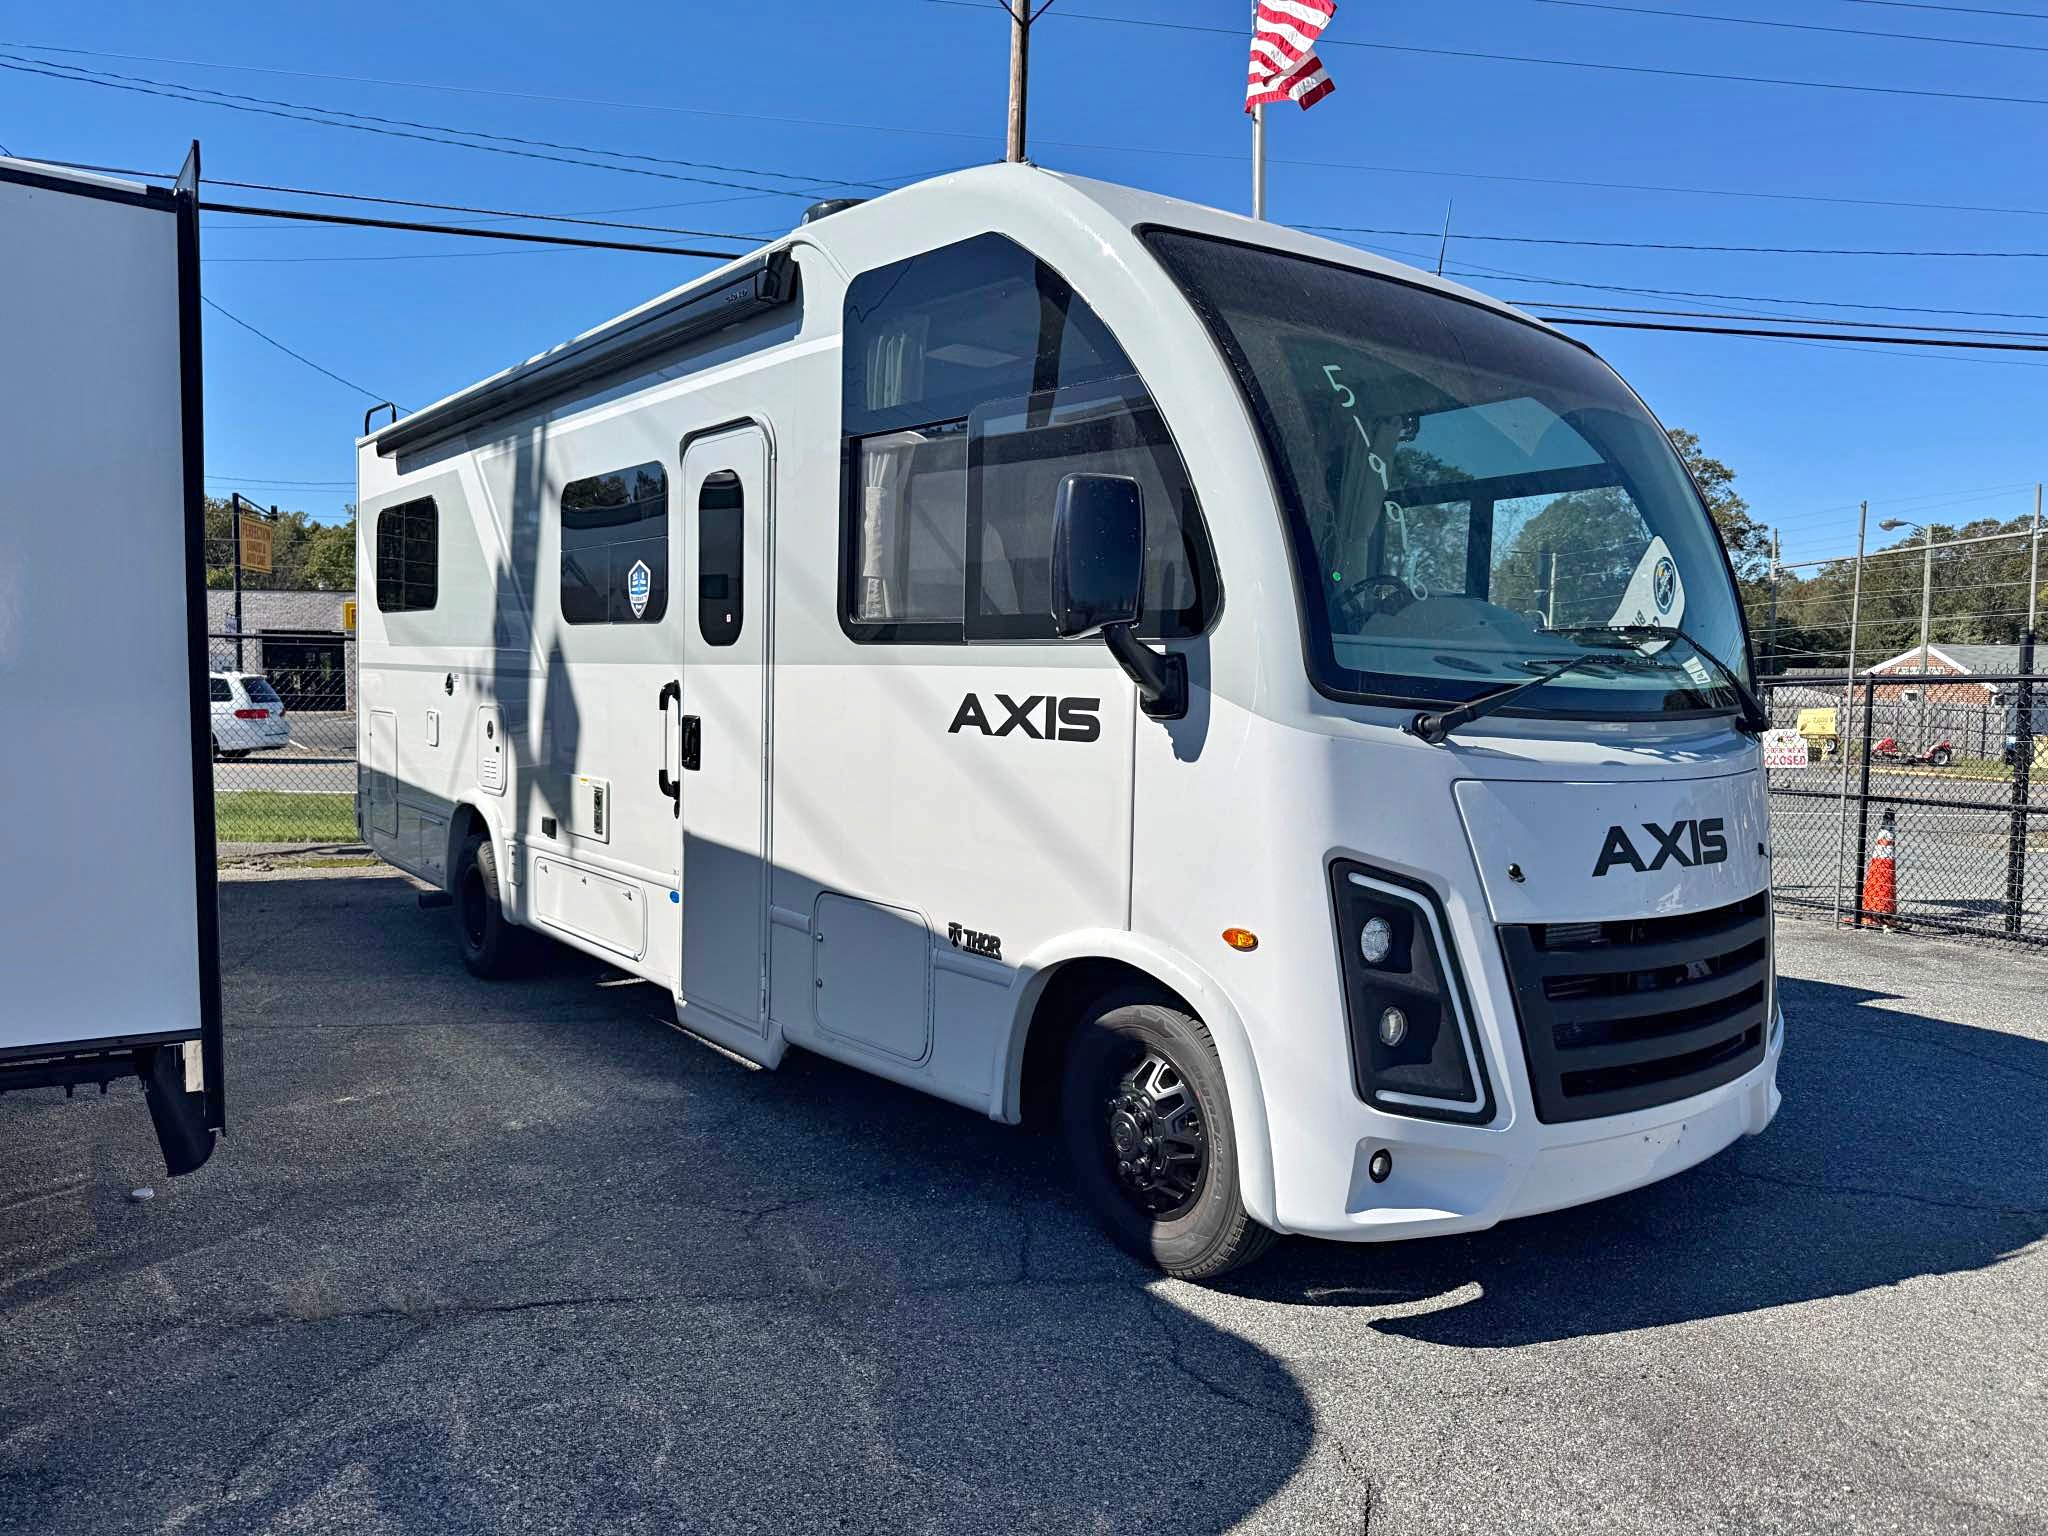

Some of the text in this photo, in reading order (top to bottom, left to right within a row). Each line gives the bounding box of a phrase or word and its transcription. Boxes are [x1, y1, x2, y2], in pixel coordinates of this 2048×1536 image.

[948, 693, 1101, 742] AXIS
[1765, 755, 1806, 766] CLOSED
[1592, 818, 1727, 877] AXIS
[963, 928, 1002, 955] THOR
